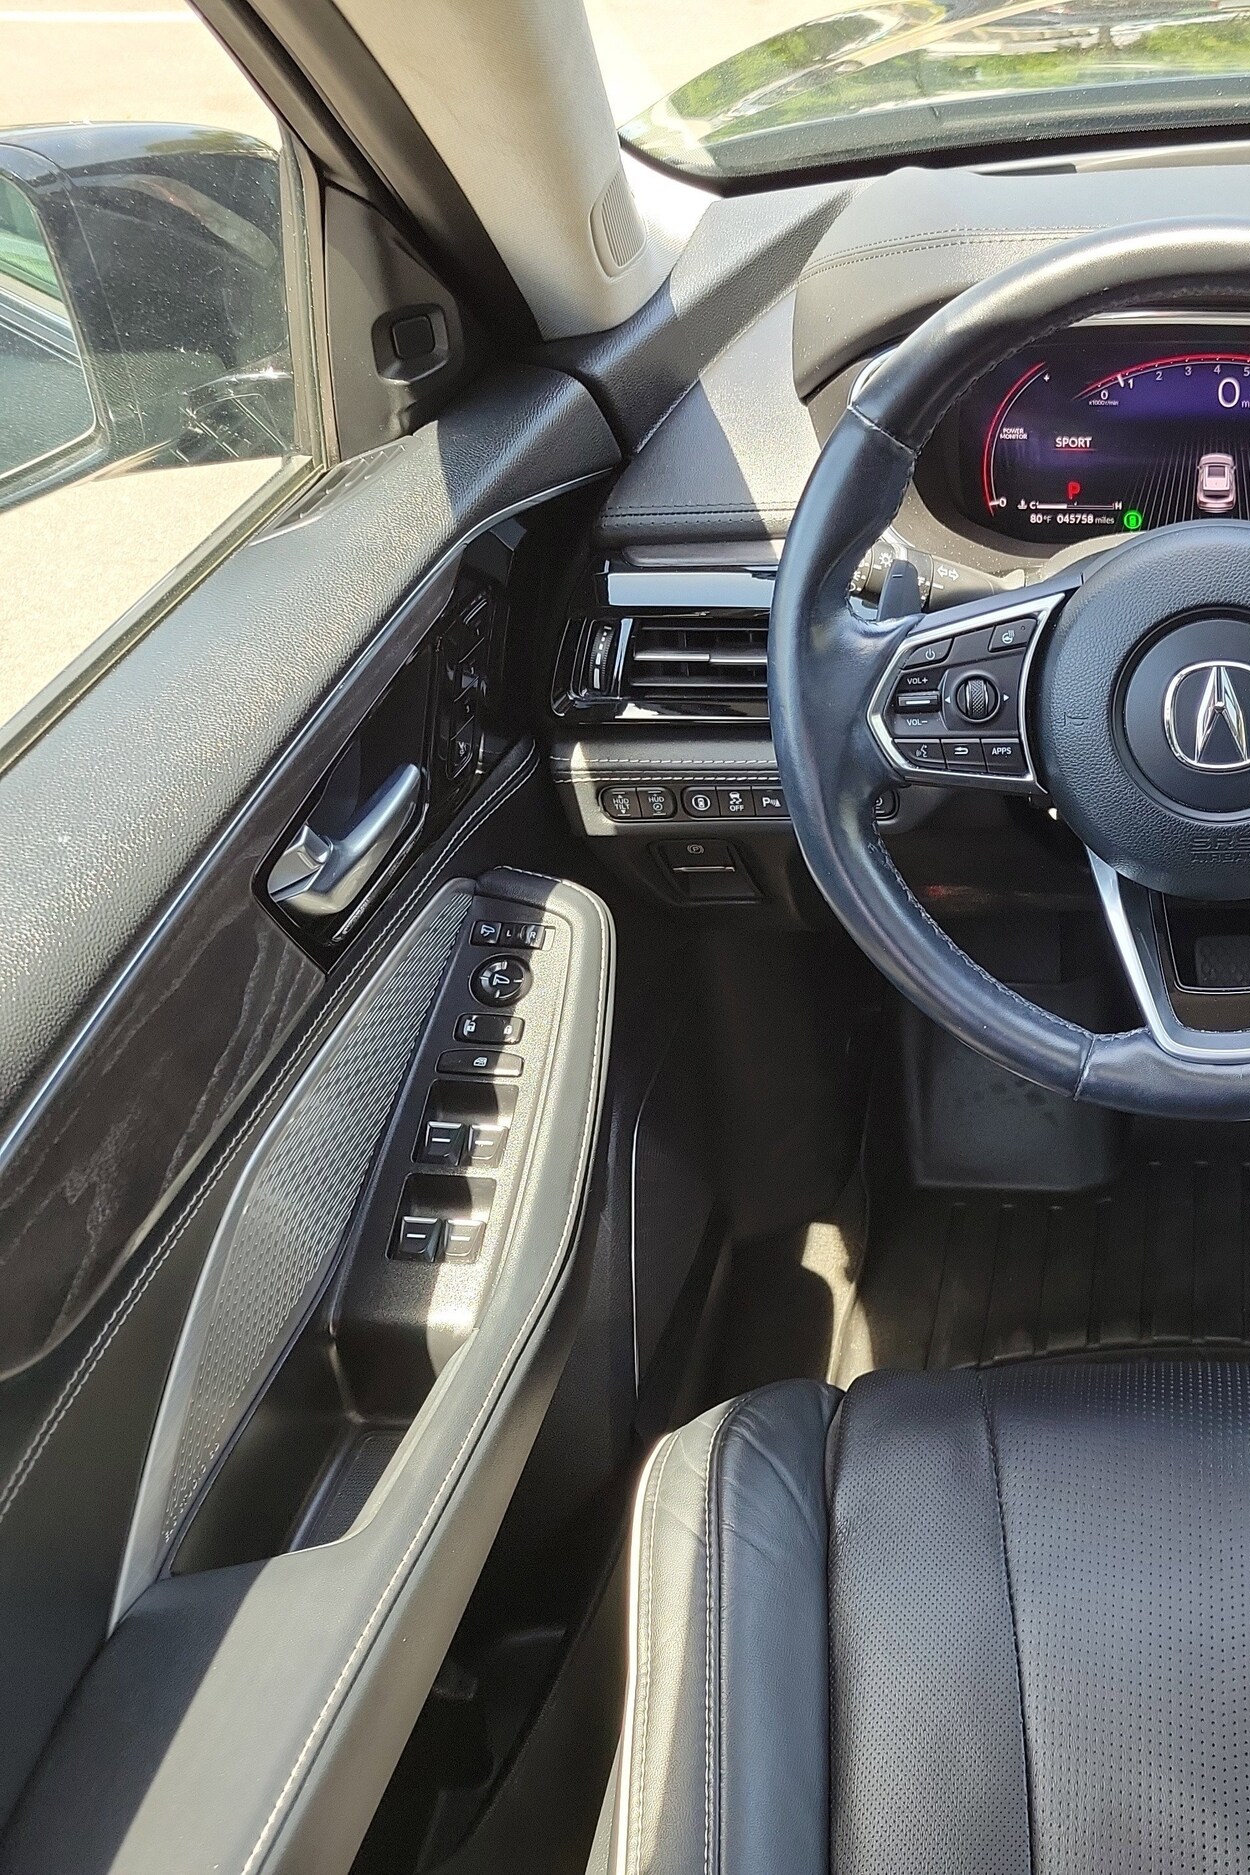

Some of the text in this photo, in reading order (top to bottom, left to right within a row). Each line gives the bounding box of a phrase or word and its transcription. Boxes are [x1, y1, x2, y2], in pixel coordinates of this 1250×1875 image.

[1185, 366, 1192, 376] 3
[1213, 364, 1221, 375] 4
[1243, 367, 1250, 377] 5
[1155, 371, 1163, 381] 2
[1127, 378, 1134, 389] 1
[1100, 389, 1109, 400] 0
[1217, 376, 1240, 408] 0
[1055, 437, 1093, 448] SPORT
[1067, 481, 1081, 500] P
[1000, 498, 1007, 507] 0
[1029, 501, 1036, 509] C
[1114, 501, 1123, 510] H
[1056, 514, 1094, 524] 045758
[1095, 515, 1115, 524] miles
[907, 677, 928, 685] VOL+
[992, 747, 1012, 755] APPS
[530, 931, 536, 939] R
